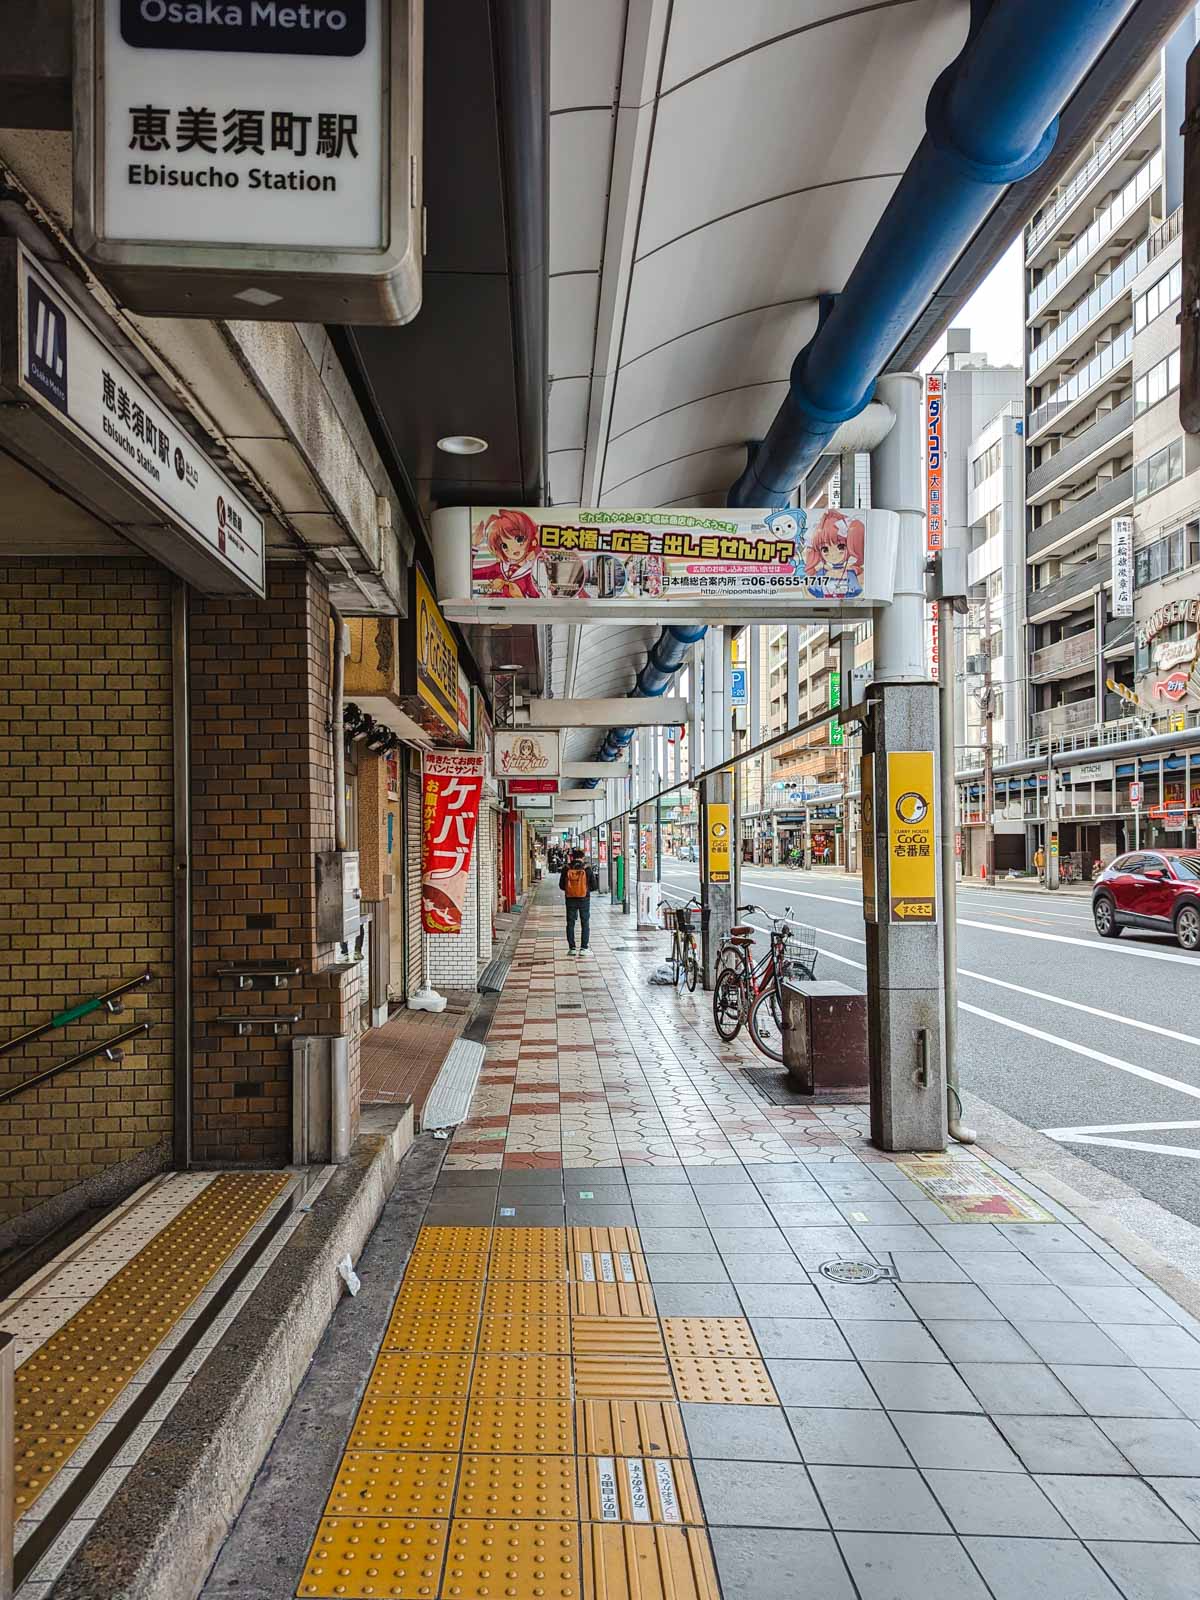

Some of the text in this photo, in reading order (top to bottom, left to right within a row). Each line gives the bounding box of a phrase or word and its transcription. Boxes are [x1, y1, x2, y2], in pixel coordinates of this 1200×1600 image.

[140, 0, 347, 30] Osaka Metro
[128, 104, 359, 159] 恵美須町駅
[128, 164, 337, 192] Ebisucho Station
[928, 376, 941, 391] 薬
[102, 368, 171, 469] 恵美須町駅
[102, 415, 161, 482] Ebisucho Station
[928, 400, 942, 470] ダイコク
[540, 525, 795, 564] 日本橋に広告を出しませんか?
[661, 576, 830, 587] 日本橋総合案内所 06-6655-1717
[732, 672, 741, 689] P
[426, 754, 484, 766] 焼きたてお肉を
[428, 763, 479, 774] パンにサンド
[431, 778, 476, 880] ケバブ
[897, 834, 927, 844] CoCo
[894, 844, 930, 857] 壱番屋
[903, 905, 931, 914] すぐそこ
[601, 1474, 616, 1518] 目の不自由な
